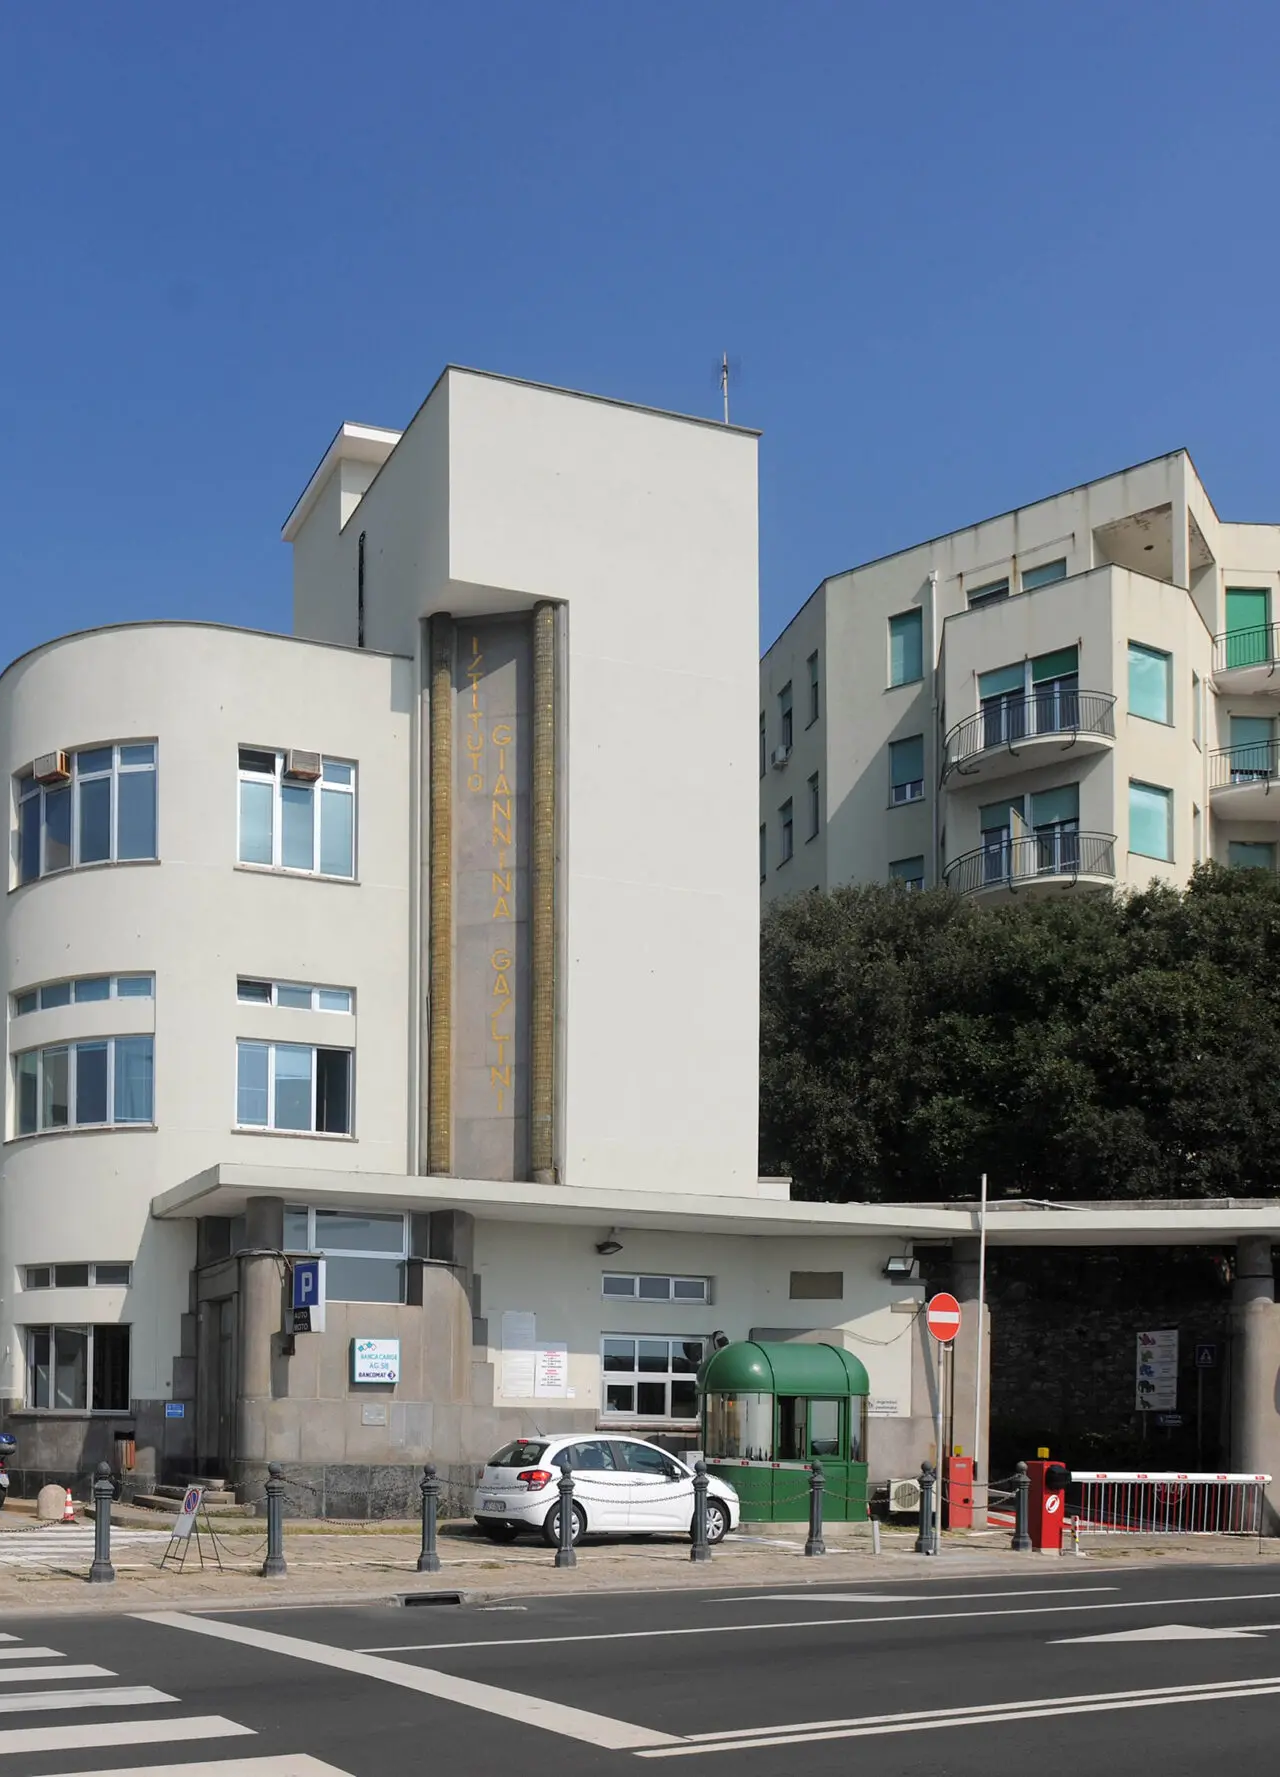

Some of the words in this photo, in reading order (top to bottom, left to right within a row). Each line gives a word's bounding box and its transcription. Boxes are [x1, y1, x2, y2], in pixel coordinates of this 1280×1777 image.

[466, 636, 483, 793] ISTITUTO
[490, 724, 513, 918] GIANNINA
[489, 948, 513, 1112] GASLINI
[301, 1272, 313, 1302] P
